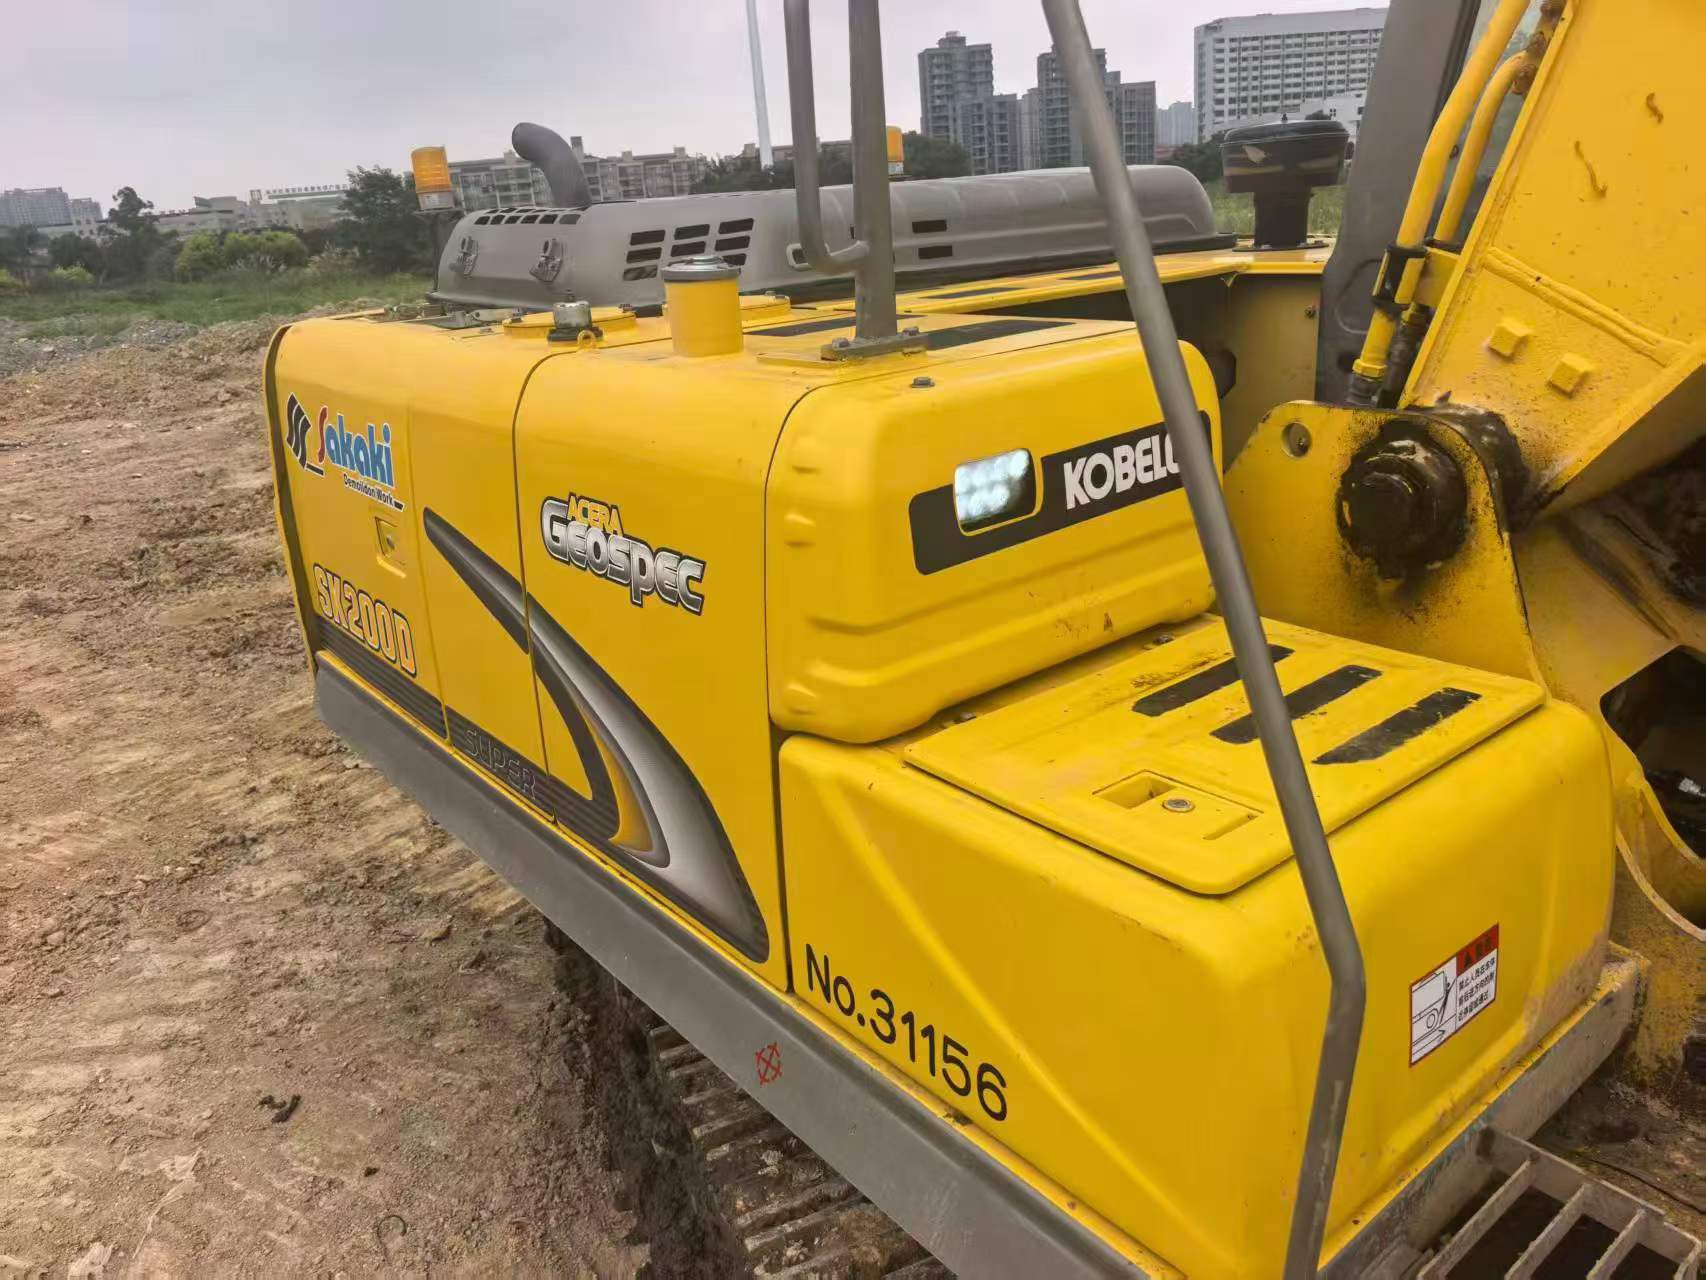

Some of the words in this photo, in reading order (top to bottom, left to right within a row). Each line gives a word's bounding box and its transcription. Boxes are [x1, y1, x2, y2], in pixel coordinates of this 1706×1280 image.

[317, 405, 395, 487] Sakaki
[375, 487, 394, 507] Work
[566, 492, 624, 537] ACERA
[805, 943, 1007, 1121] No.31156
